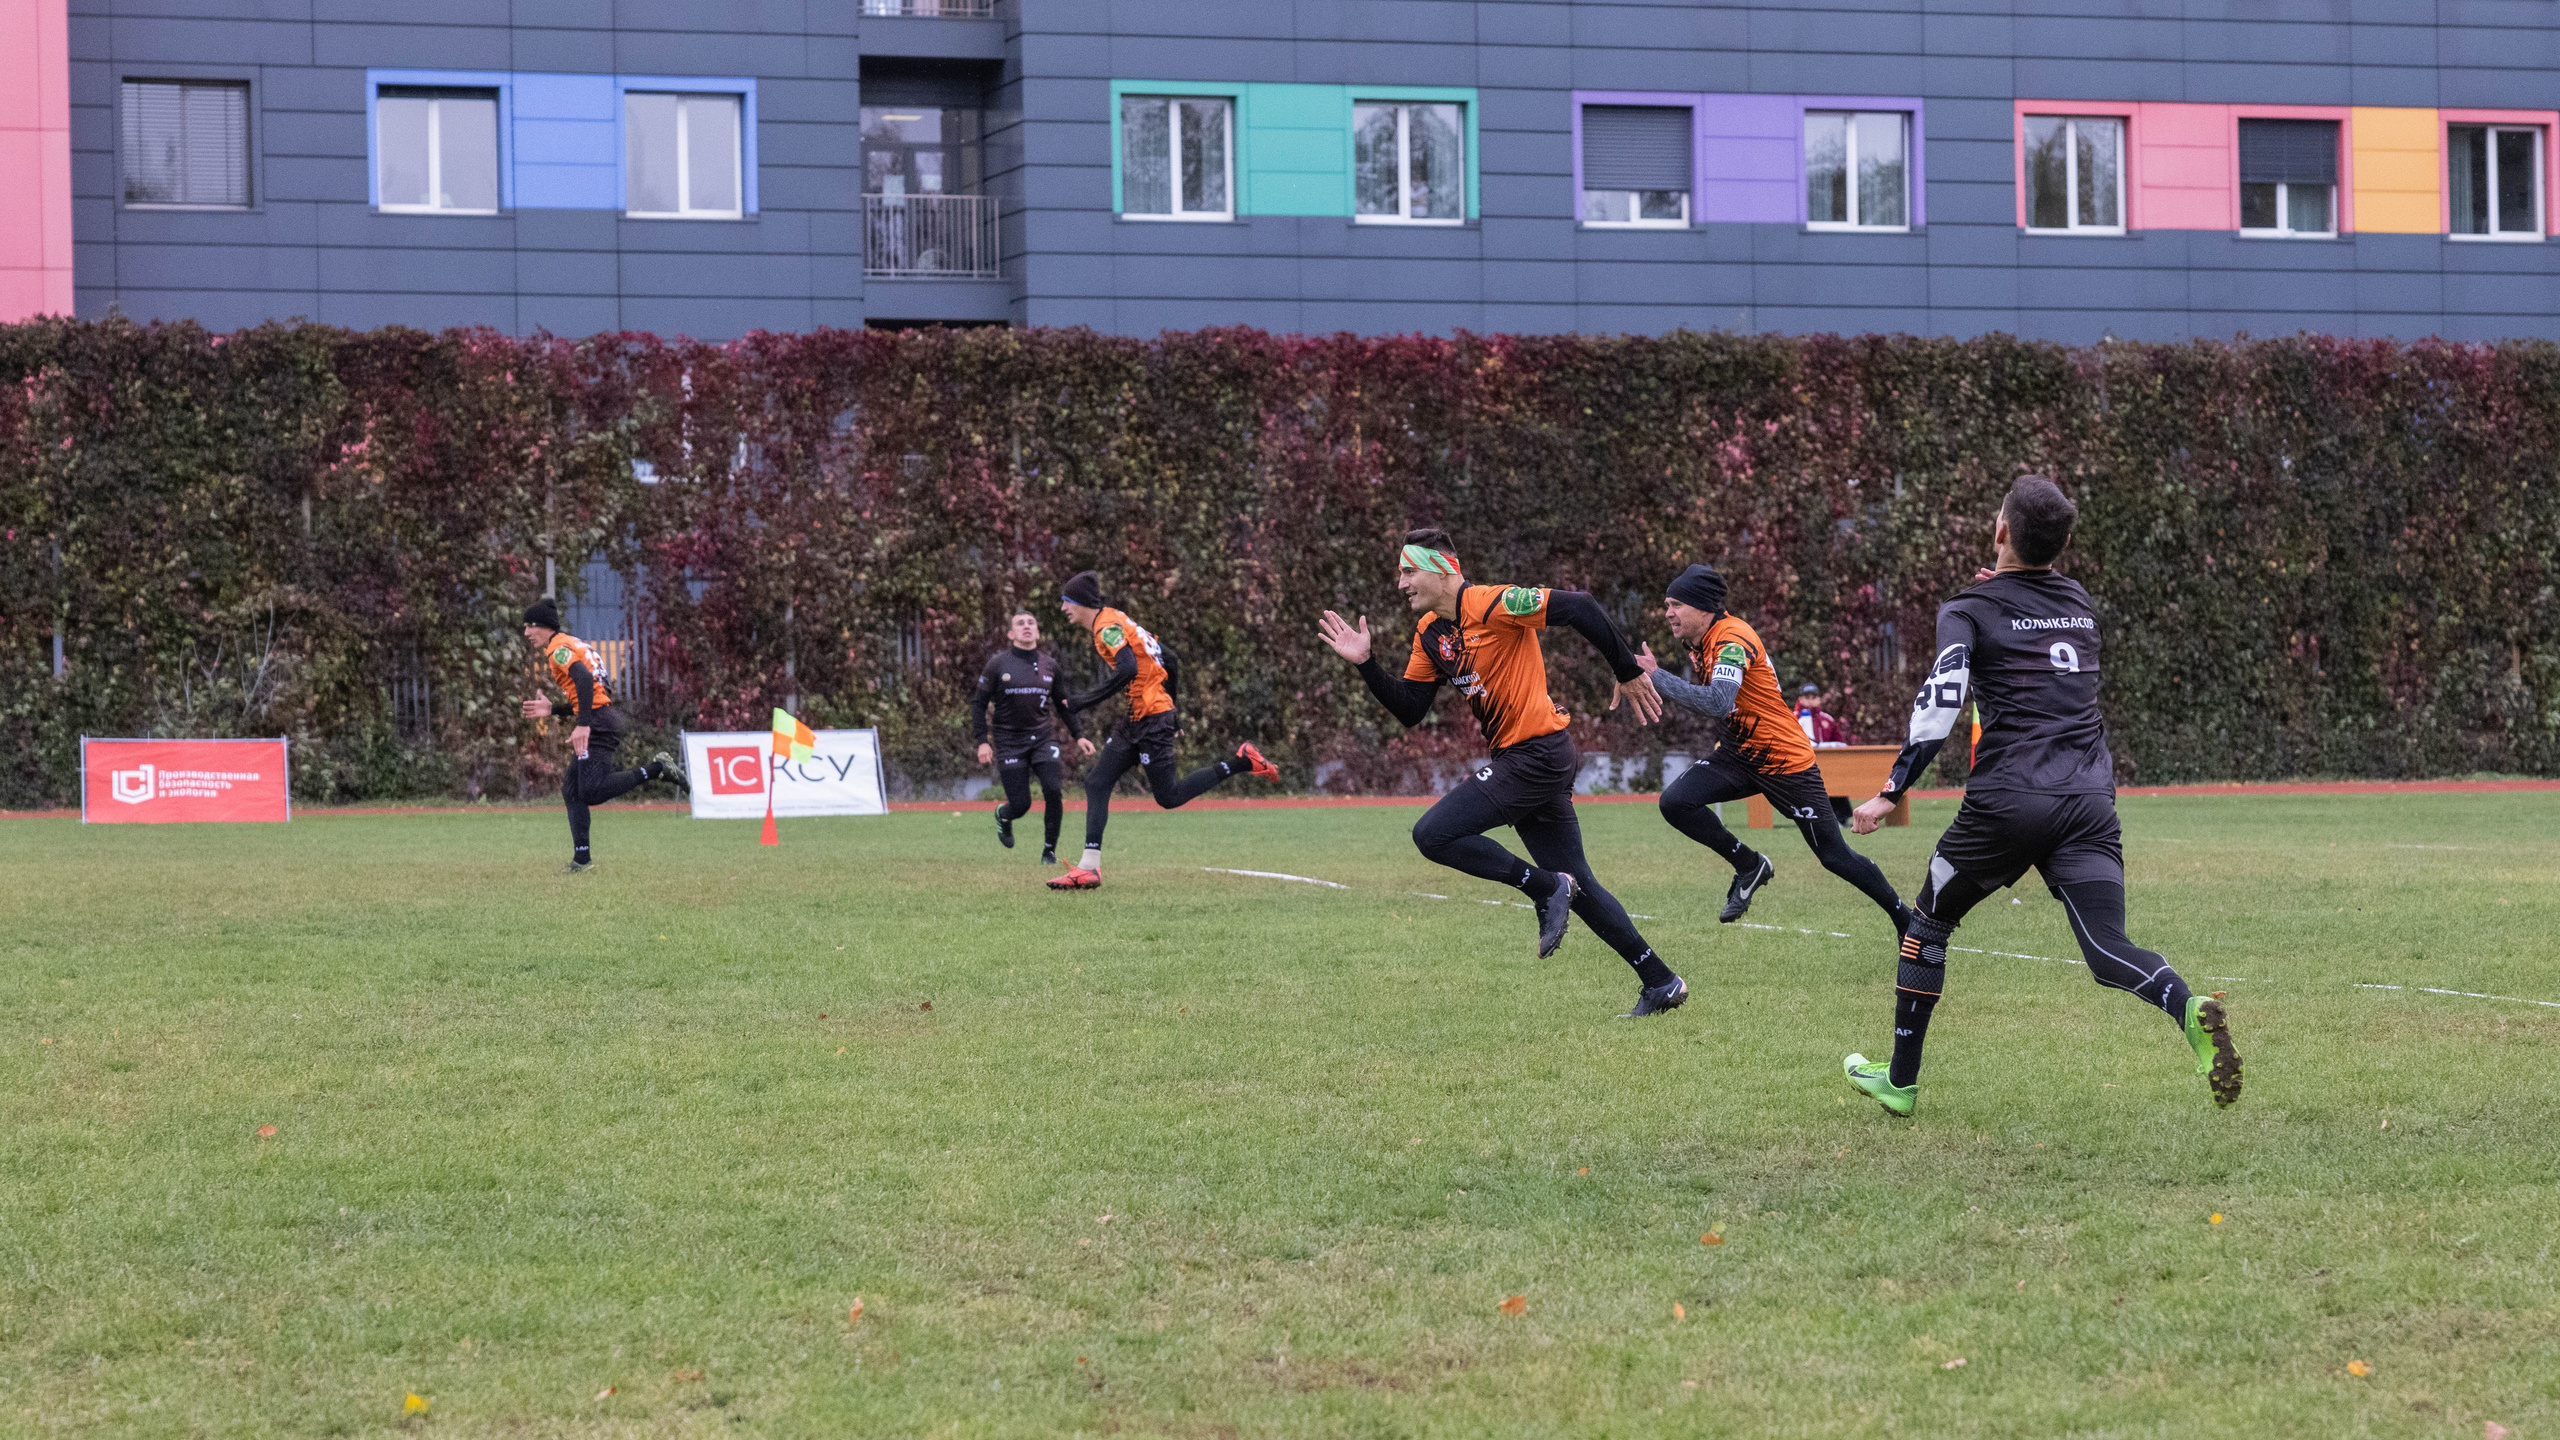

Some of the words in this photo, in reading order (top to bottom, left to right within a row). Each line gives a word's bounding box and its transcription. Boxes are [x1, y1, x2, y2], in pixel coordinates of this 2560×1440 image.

[2012, 616, 2096, 630] КОЛЫКБАСОВ
[2049, 641, 2081, 676] 9
[1050, 745, 1060, 758] 7
[158, 769, 260, 781] Производственная
[1475, 767, 1493, 782] 3
[158, 779, 232, 789] безопасность
[158, 789, 166, 798] и
[168, 787, 217, 798] экология
[1790, 805, 1818, 819] 12
[1633, 947, 1652, 966] LAP
